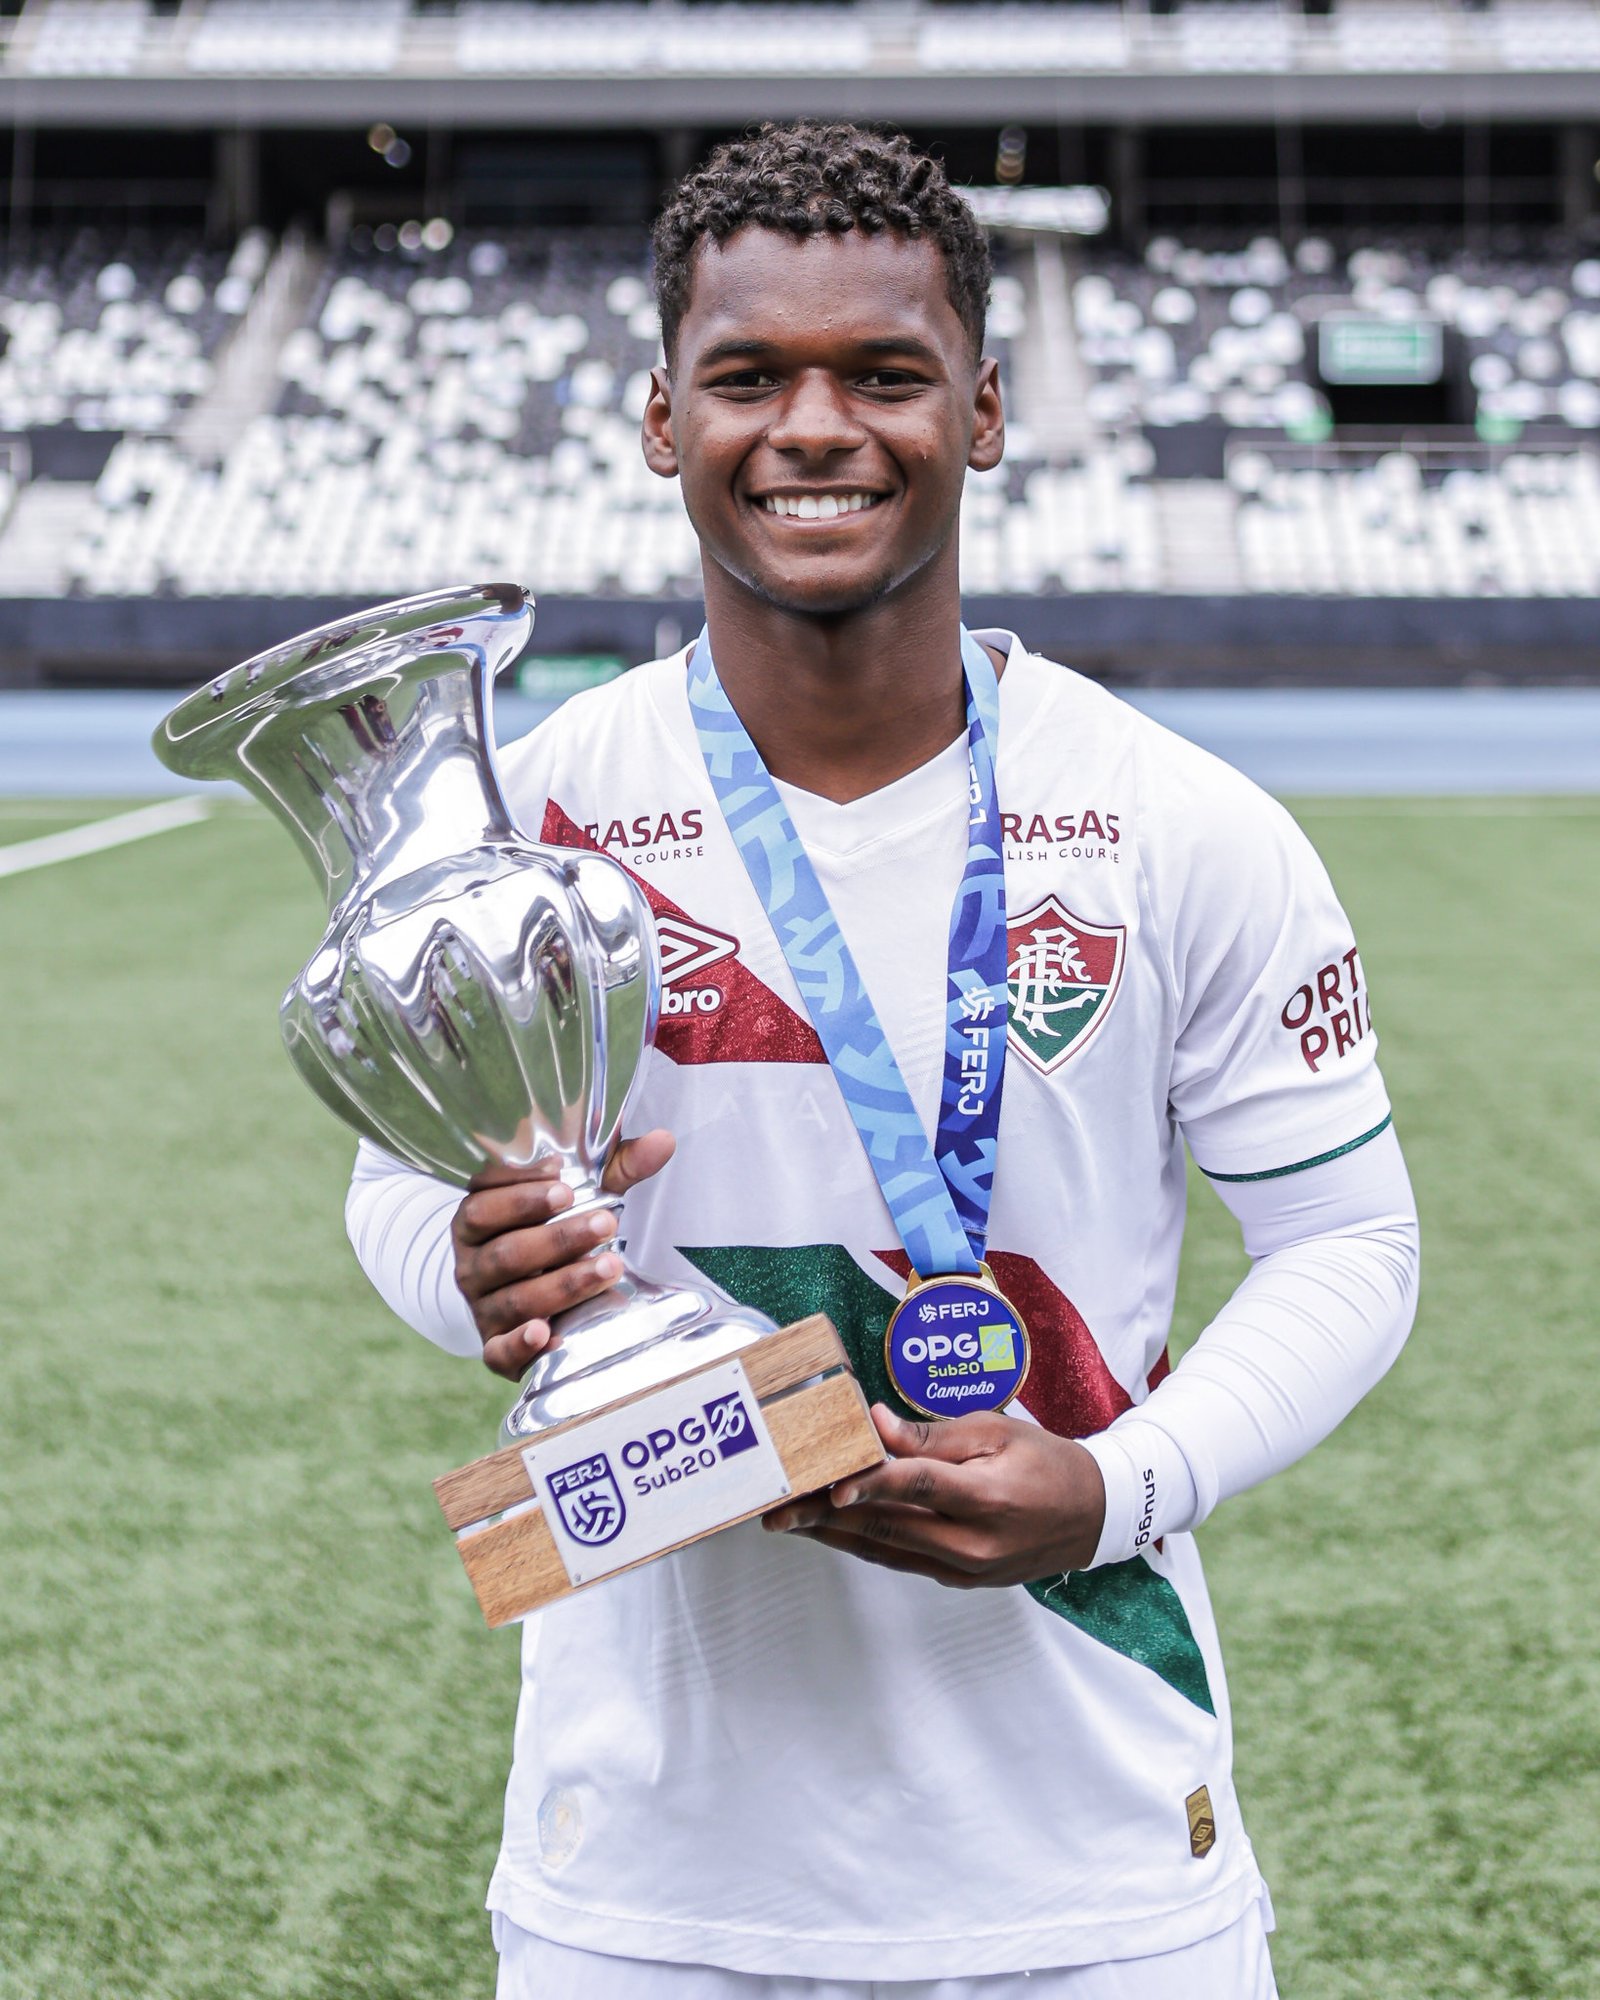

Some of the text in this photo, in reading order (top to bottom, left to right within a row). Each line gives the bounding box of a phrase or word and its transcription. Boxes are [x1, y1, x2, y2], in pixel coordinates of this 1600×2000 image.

[634, 846, 704, 865] COURSE
[1007, 847, 1120, 863] LISH COURE
[661, 986, 721, 1015] bro
[1300, 992, 1371, 1074] PRI
[957, 1027, 989, 1115] FERJ
[939, 1301, 990, 1320] FERJ
[902, 1333, 979, 1363] OPG
[928, 1361, 980, 1378] Sub20
[926, 1381, 995, 1401] Campeão
[621, 1417, 706, 1469] OPG
[551, 1459, 607, 1496] FERJ
[633, 1448, 717, 1497] Sub20
